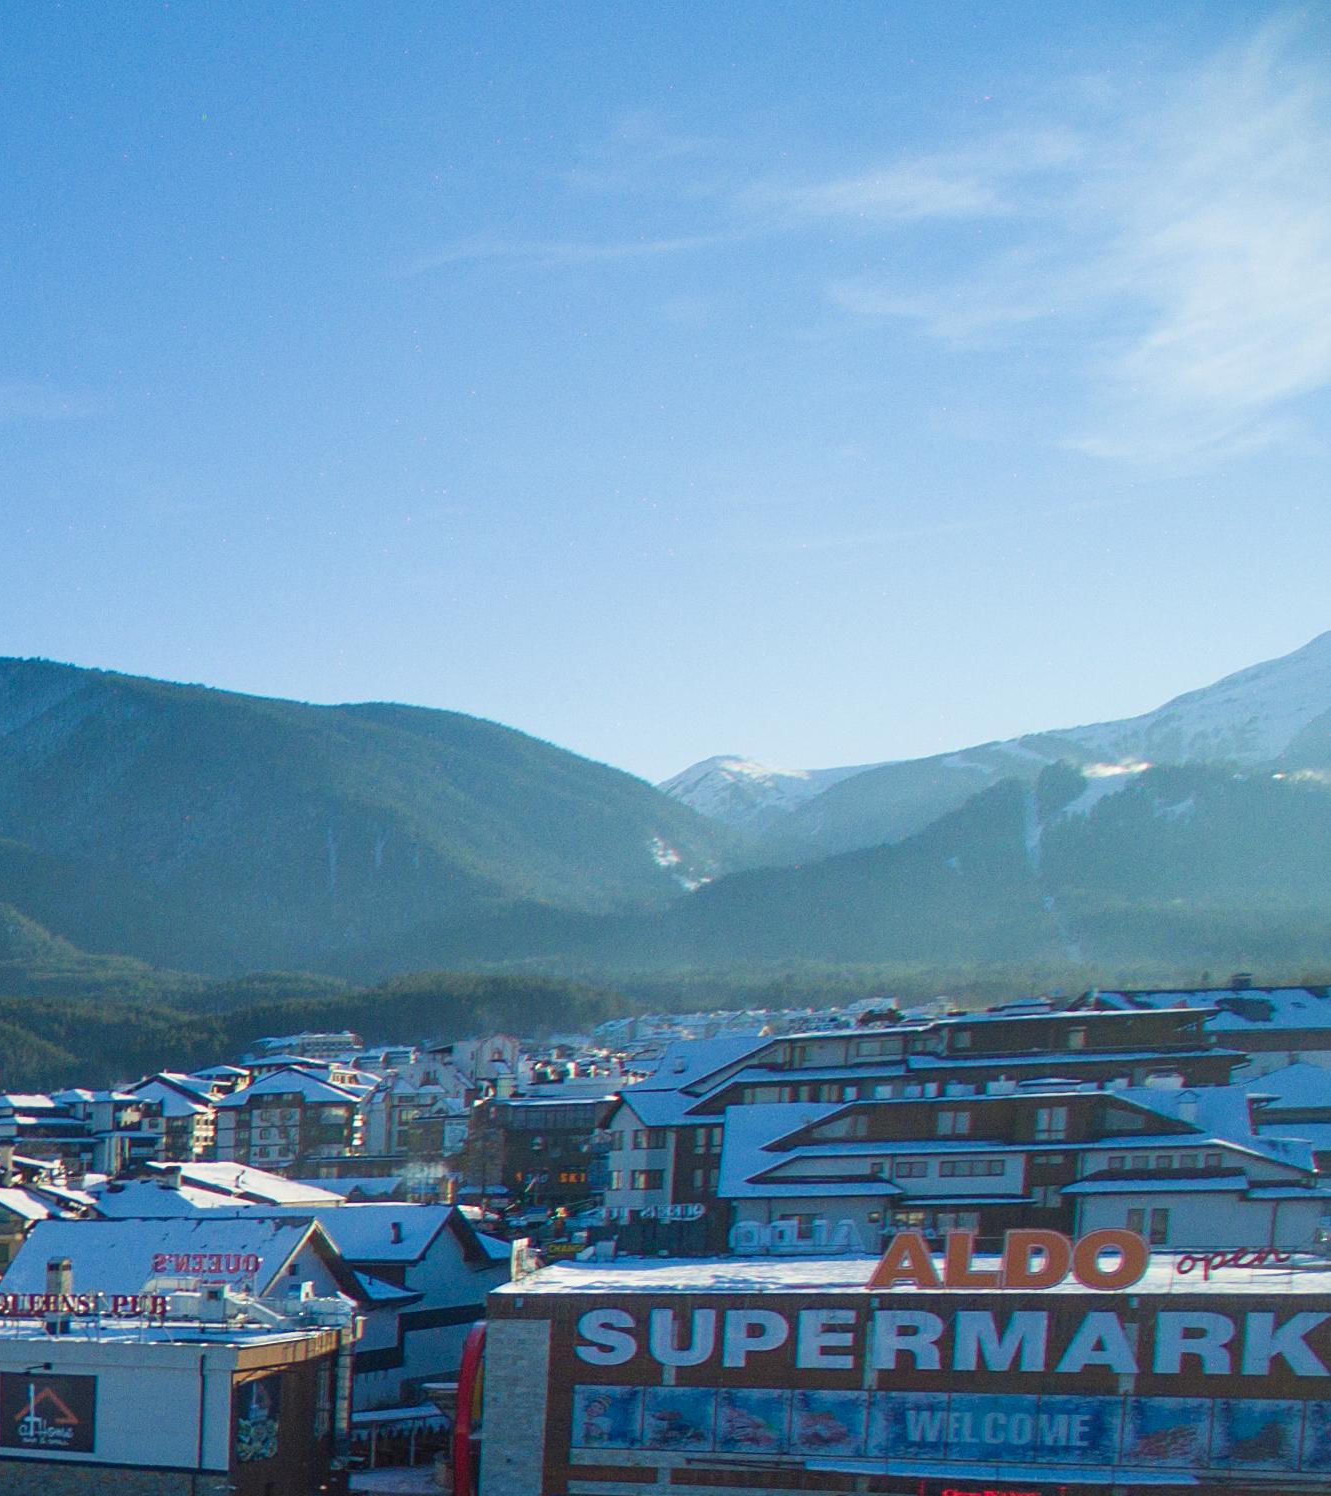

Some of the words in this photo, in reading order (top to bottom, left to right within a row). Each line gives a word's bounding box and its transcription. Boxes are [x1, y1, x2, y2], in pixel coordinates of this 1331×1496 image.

[867, 1228, 1151, 1291] ALDO
[1176, 1247, 1290, 1281] open
[111, 1294, 169, 1317] PUB
[576, 1308, 1331, 1376] SUPERMARK
[905, 1409, 1091, 1447] WELCOME
